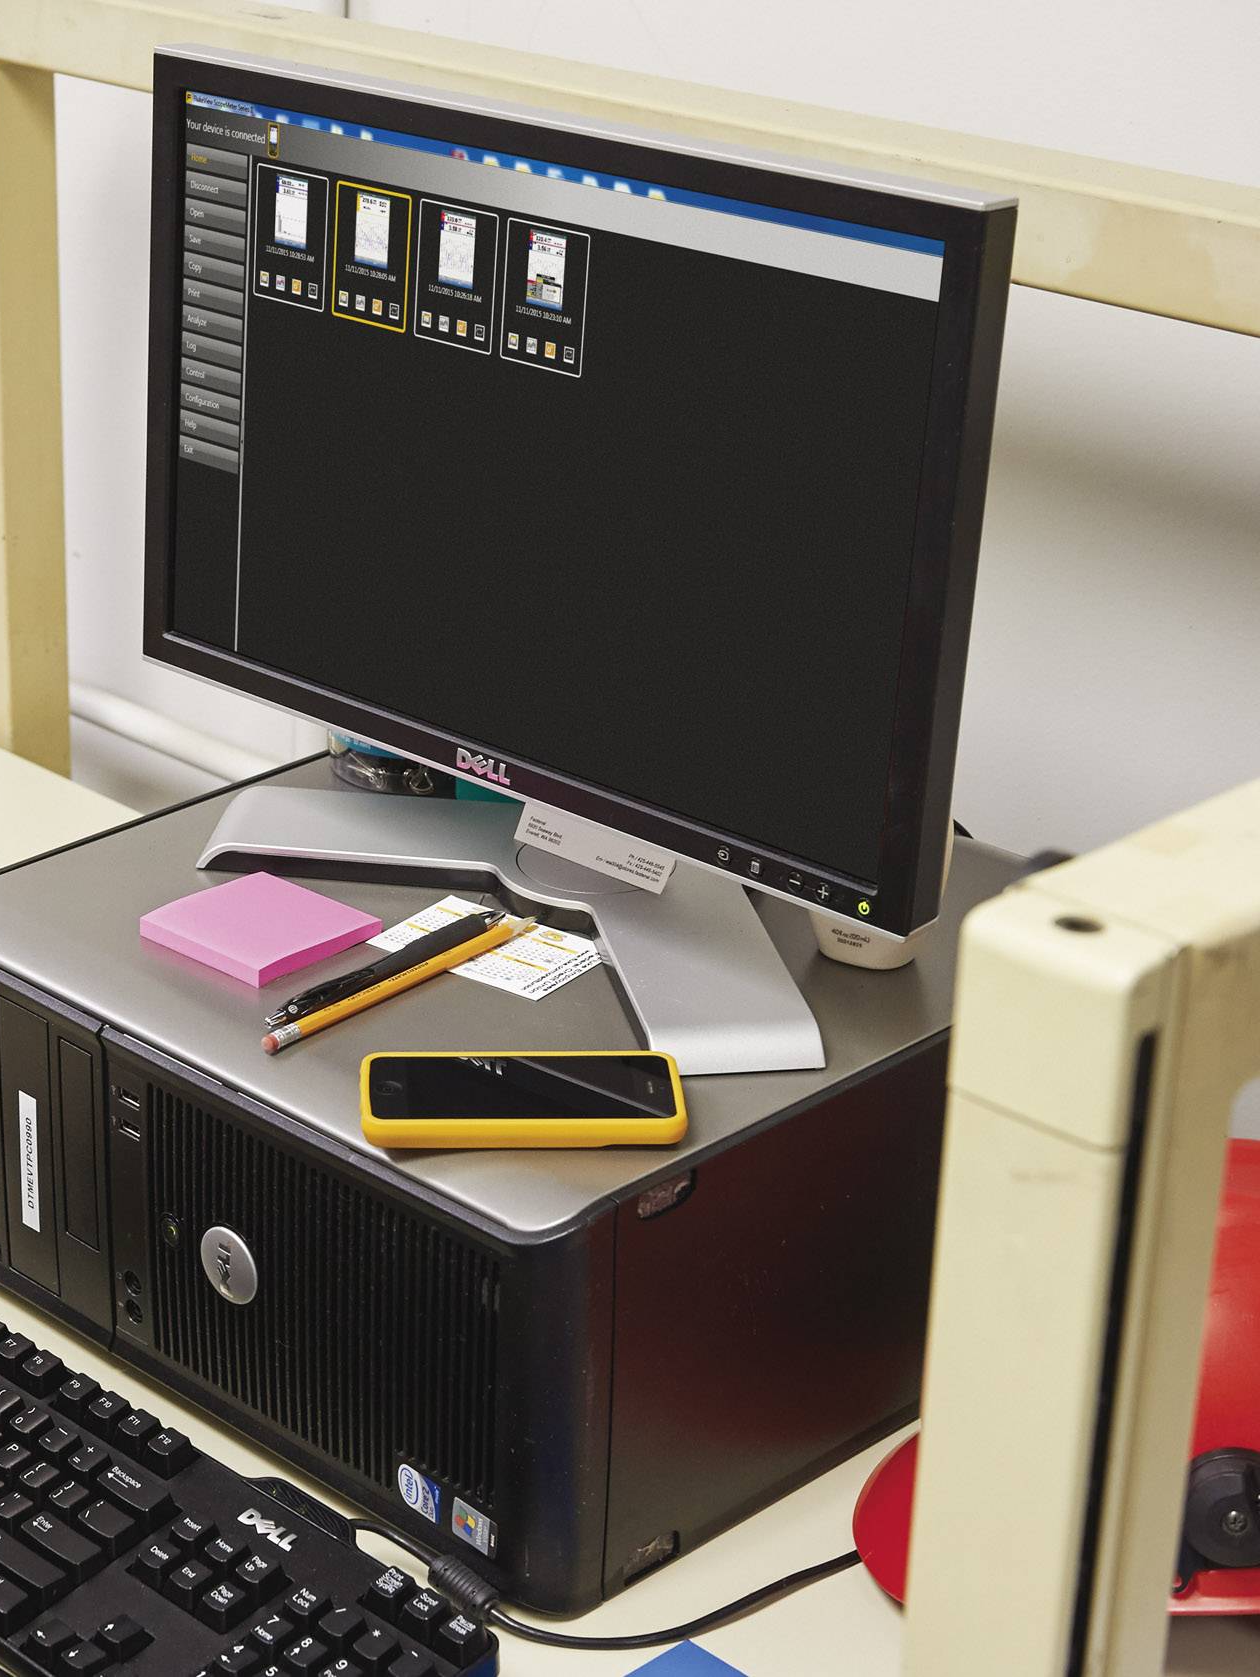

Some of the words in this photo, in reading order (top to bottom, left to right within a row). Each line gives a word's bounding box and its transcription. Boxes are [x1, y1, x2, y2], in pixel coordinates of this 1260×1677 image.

[186, 119, 201, 130] Your
[202, 122, 224, 136] device
[225, 125, 230, 136] is
[231, 130, 266, 144] connected
[191, 152, 208, 164] Home
[190, 180, 219, 194] Disconnect
[189, 208, 205, 218] Open
[189, 234, 202, 244] Save
[265, 245, 288, 257] 11/11/2015
[306, 255, 315, 263] AM
[188, 261, 202, 274] Copy
[345, 264, 369, 276] 11/11/2015
[388, 275, 397, 283] AM
[187, 288, 200, 298] Print
[428, 284, 453, 297] 11/11/2015
[473, 295, 482, 303] AM
[187, 315, 207, 327] Analyze
[515, 305, 542, 318] 11/11/2015
[562, 316, 572, 325] AM
[186, 341, 197, 352] Log
[186, 367, 205, 379] Control
[185, 393, 220, 409] Configuration
[185, 419, 197, 430] Help
[184, 445, 194, 454] Exit
[456, 747, 511, 785] DELL
[25, 1117, 35, 1210] DTMEVTPC0990
[5, 1338, 17, 1348] F7
[32, 1355, 44, 1365] F8
[69, 1379, 81, 1389] F9
[98, 1396, 113, 1409] F10
[127, 1415, 141, 1426] F11
[157, 1433, 172, 1445] F12
[6, 1443, 19, 1451] P
[111, 1465, 142, 1489] Backspace
[404, 1473, 414, 1500] intel
[35, 1515, 53, 1530] Enter
[183, 1517, 202, 1532] Insert
[236, 1507, 298, 1552] DELL
[150, 1545, 169, 1561] Delete
[215, 1538, 234, 1554] Home
[244, 1561, 255, 1572] Up
[251, 1555, 268, 1569] Page
[181, 1566, 197, 1579] End
[210, 1590, 229, 1605] Down
[217, 1585, 234, 1599] Page
[299, 1587, 317, 1602] Num
[292, 1593, 310, 1609] Lock
[412, 1598, 429, 1613] Lock
[420, 1592, 439, 1607] Scroll
[267, 1614, 280, 1625] 7
[456, 1614, 477, 1631] Pause
[254, 1625, 274, 1641] Home
[448, 1621, 467, 1636] Break
[233, 1645, 245, 1654] 4
[300, 1637, 313, 1648] 8
[265, 1666, 279, 1677] 5
[335, 1659, 348, 1670] 9
